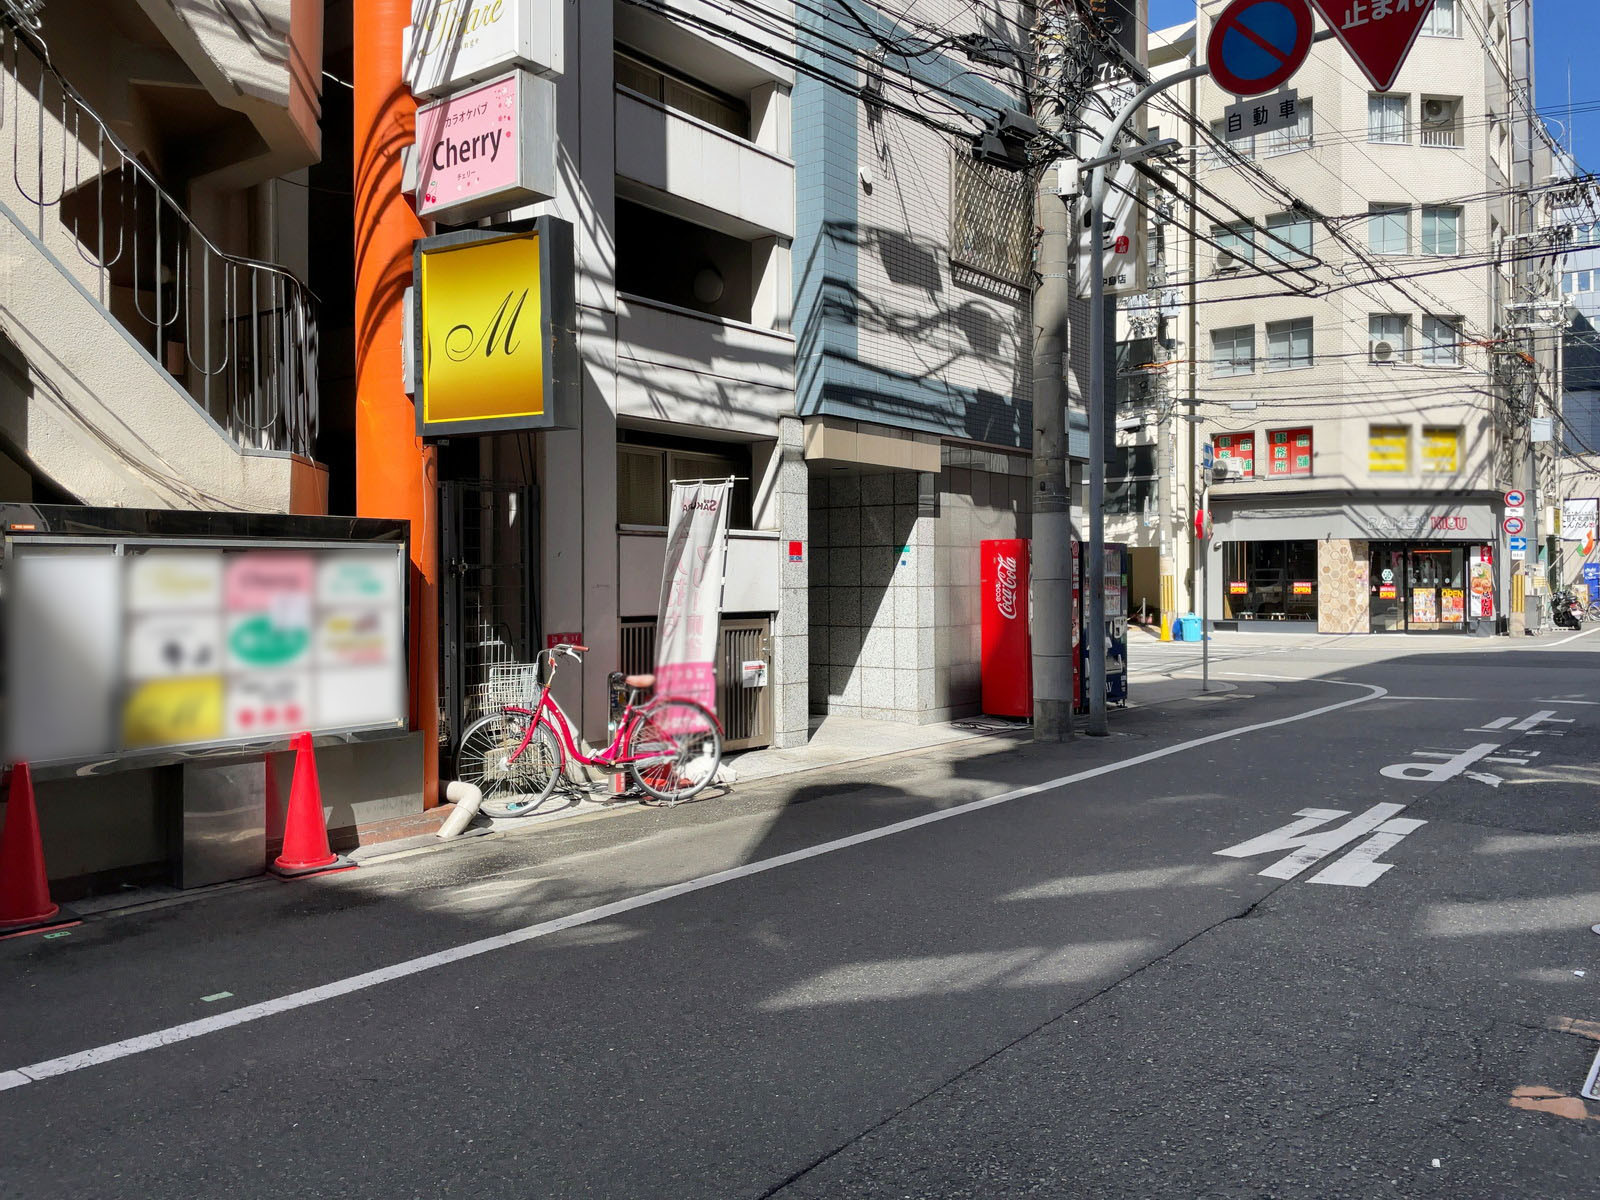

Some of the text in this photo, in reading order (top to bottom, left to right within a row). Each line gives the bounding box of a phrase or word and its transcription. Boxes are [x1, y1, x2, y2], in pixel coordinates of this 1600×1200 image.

[1228, 99, 1295, 132] 自動車
[433, 128, 502, 171] Cherry
[445, 288, 529, 362] M
[1219, 436, 1232, 458] 事務
[1275, 432, 1288, 472] 事務所
[1296, 434, 1310, 468] 店舗
[997, 553, 1017, 620] Coca-Cola
[1441, 590, 1464, 598] OPEN
